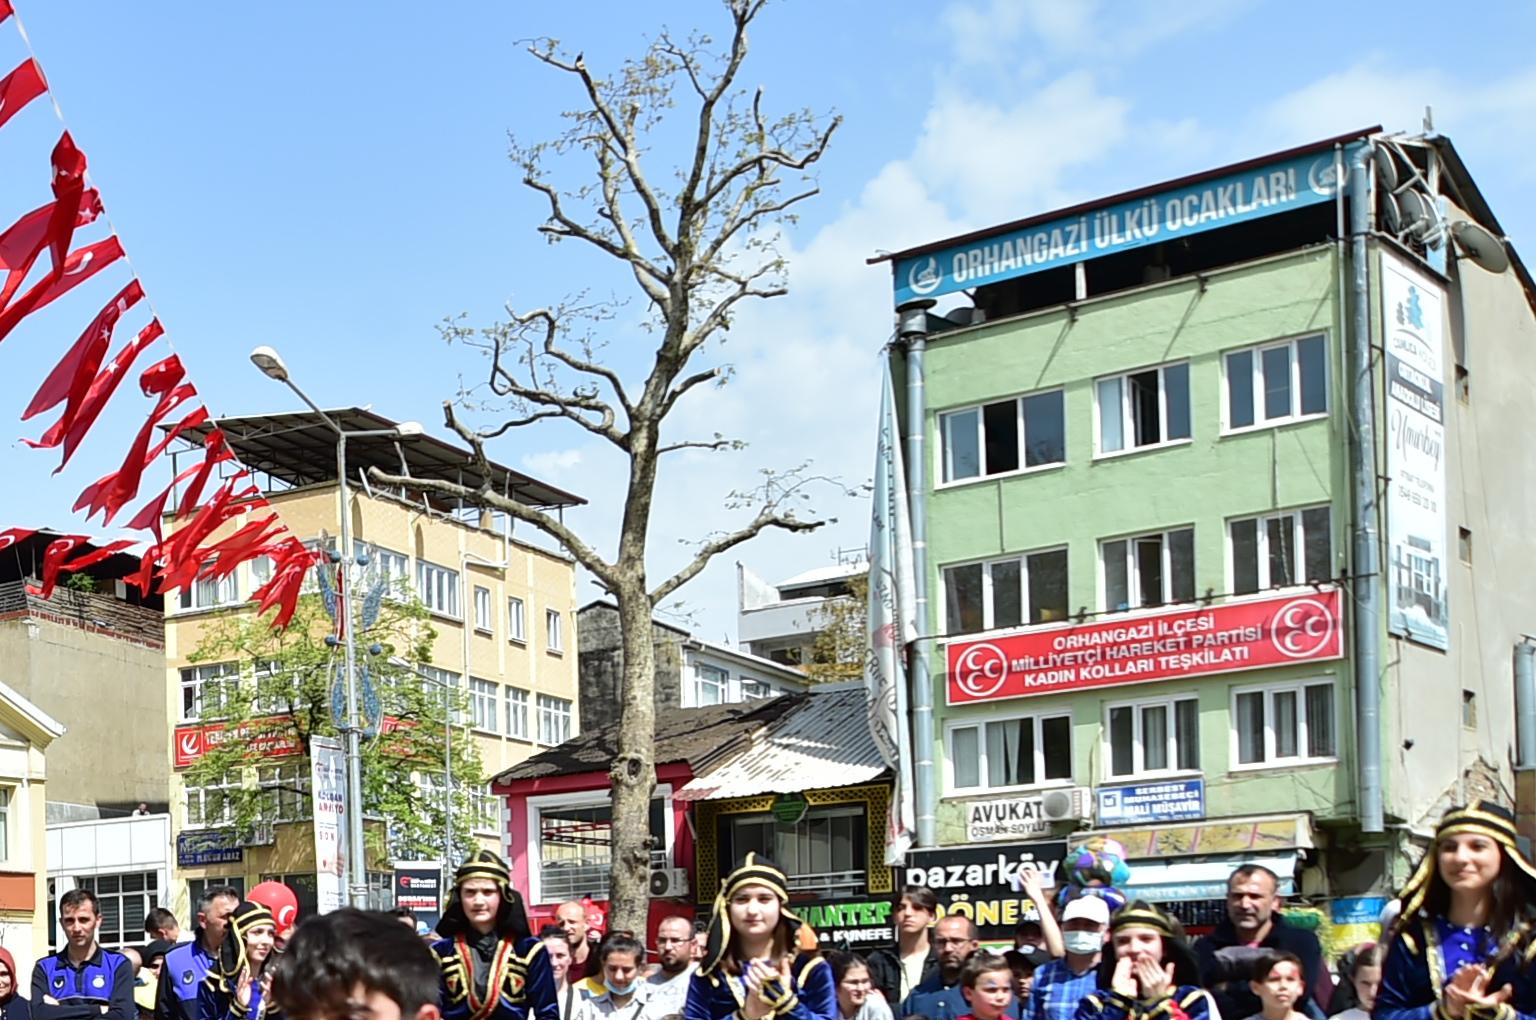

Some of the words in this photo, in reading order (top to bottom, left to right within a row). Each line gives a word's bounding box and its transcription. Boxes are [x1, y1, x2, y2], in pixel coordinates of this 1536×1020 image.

[952, 216, 1088, 284] ORHANGAZİ
[1094, 201, 1159, 250] ÜLKÜ
[1165, 167, 1297, 233] OCAKLARI
[1053, 622, 1154, 651] ORHANGAZİ
[1157, 613, 1216, 637] İLÇESİ
[1011, 648, 1102, 673] MİLLİYETÇİ
[1106, 636, 1187, 661] HAREKET
[1192, 622, 1263, 648] PARTİSİ
[1024, 670, 1076, 687] KADIN
[1079, 658, 1155, 681] KOLLARI
[1158, 645, 1249, 672] TEŞKİLATI
[1124, 789, 1199, 804] MUHASEBECİ
[1134, 784, 1186, 795] SERBEST
[972, 800, 1042, 823] AVUKAT
[1124, 802, 1151, 816] MALİ
[971, 824, 1008, 838] OSMAN
[1010, 821, 1045, 834] SOYLU
[819, 932, 830, 942] &
